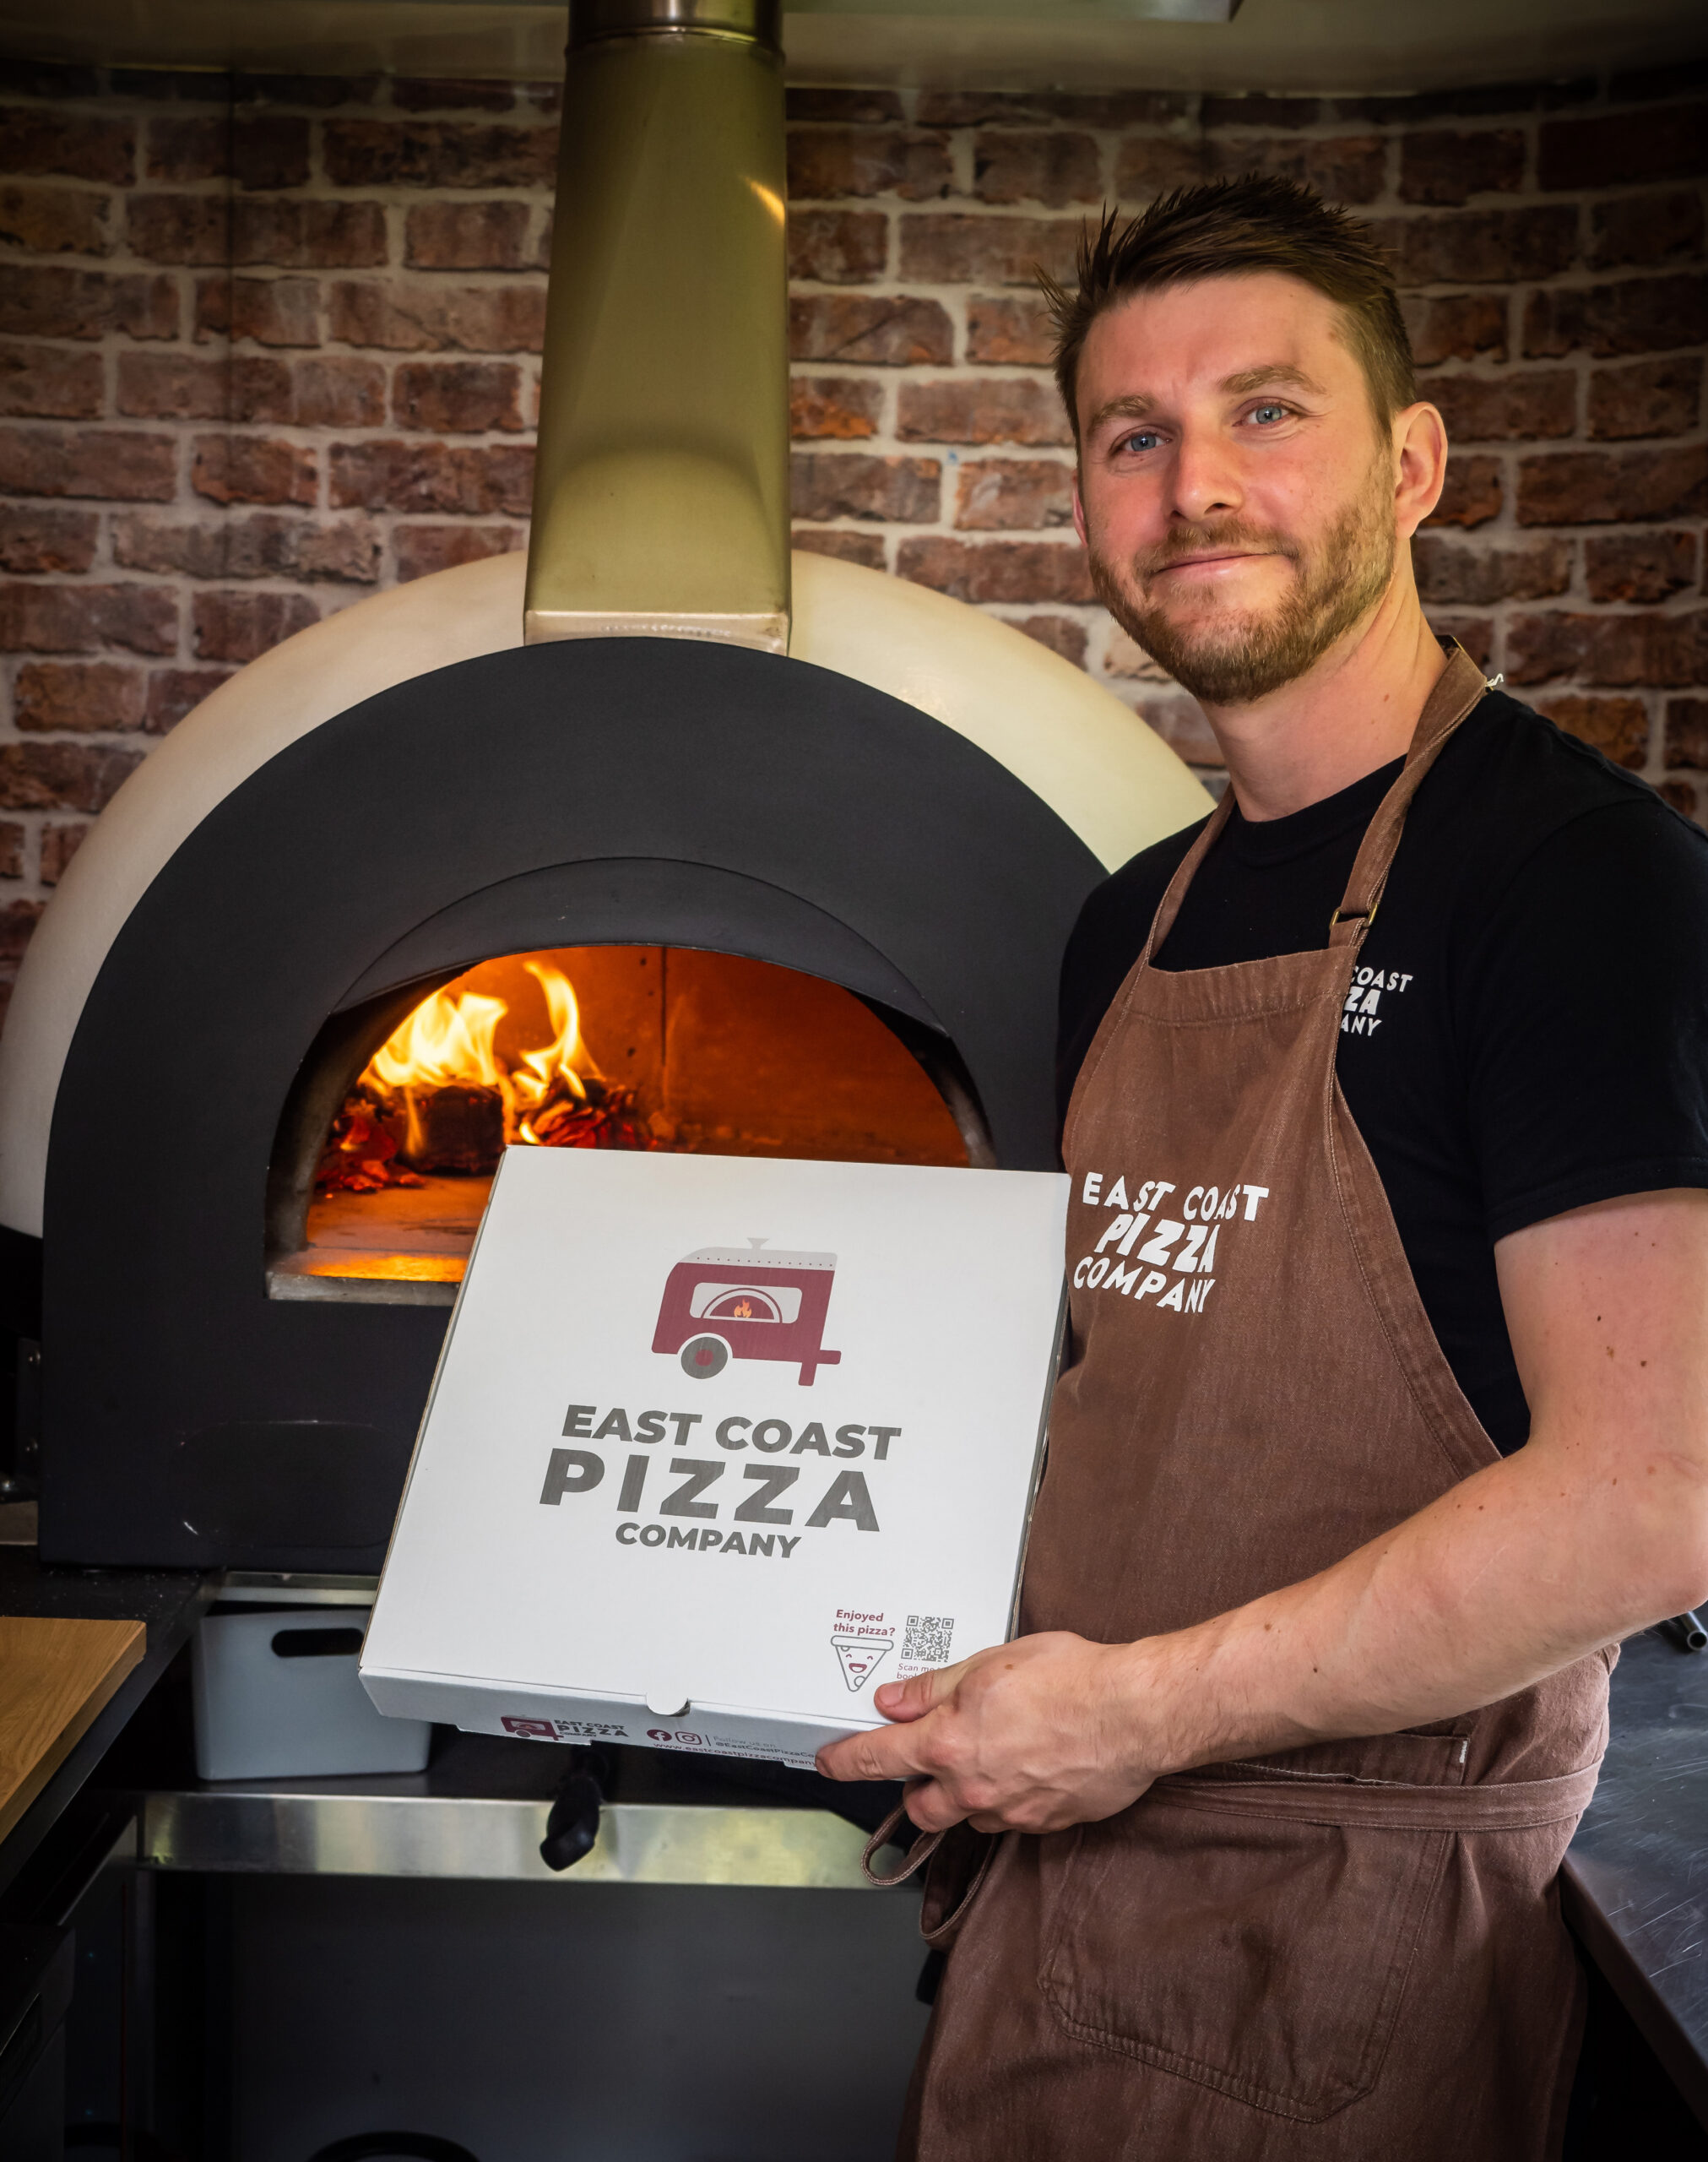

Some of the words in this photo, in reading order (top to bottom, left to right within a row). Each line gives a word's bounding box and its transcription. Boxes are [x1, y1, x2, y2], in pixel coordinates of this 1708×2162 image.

[1344, 986, 1381, 1016] ZA
[1340, 1013, 1382, 1036] ANY
[1082, 1171, 1176, 1212] EAST
[1183, 1184, 1269, 1221] COAST
[1093, 1212, 1220, 1273] PIZZA
[1073, 1257, 1216, 1312] COMPANY
[561, 1404, 702, 1446] EAST
[715, 1416, 902, 1460] COAST
[540, 1448, 880, 1532] PIZZA
[615, 1522, 801, 1558] COMPANY
[833, 1623, 854, 1632] this
[858, 1625, 896, 1636] pizza?
[836, 1609, 884, 1622] Enjoyed
[897, 1663, 919, 1671] Scan
[557, 1725, 629, 1737] PIZZA
[713, 1736, 746, 1744] Follow
